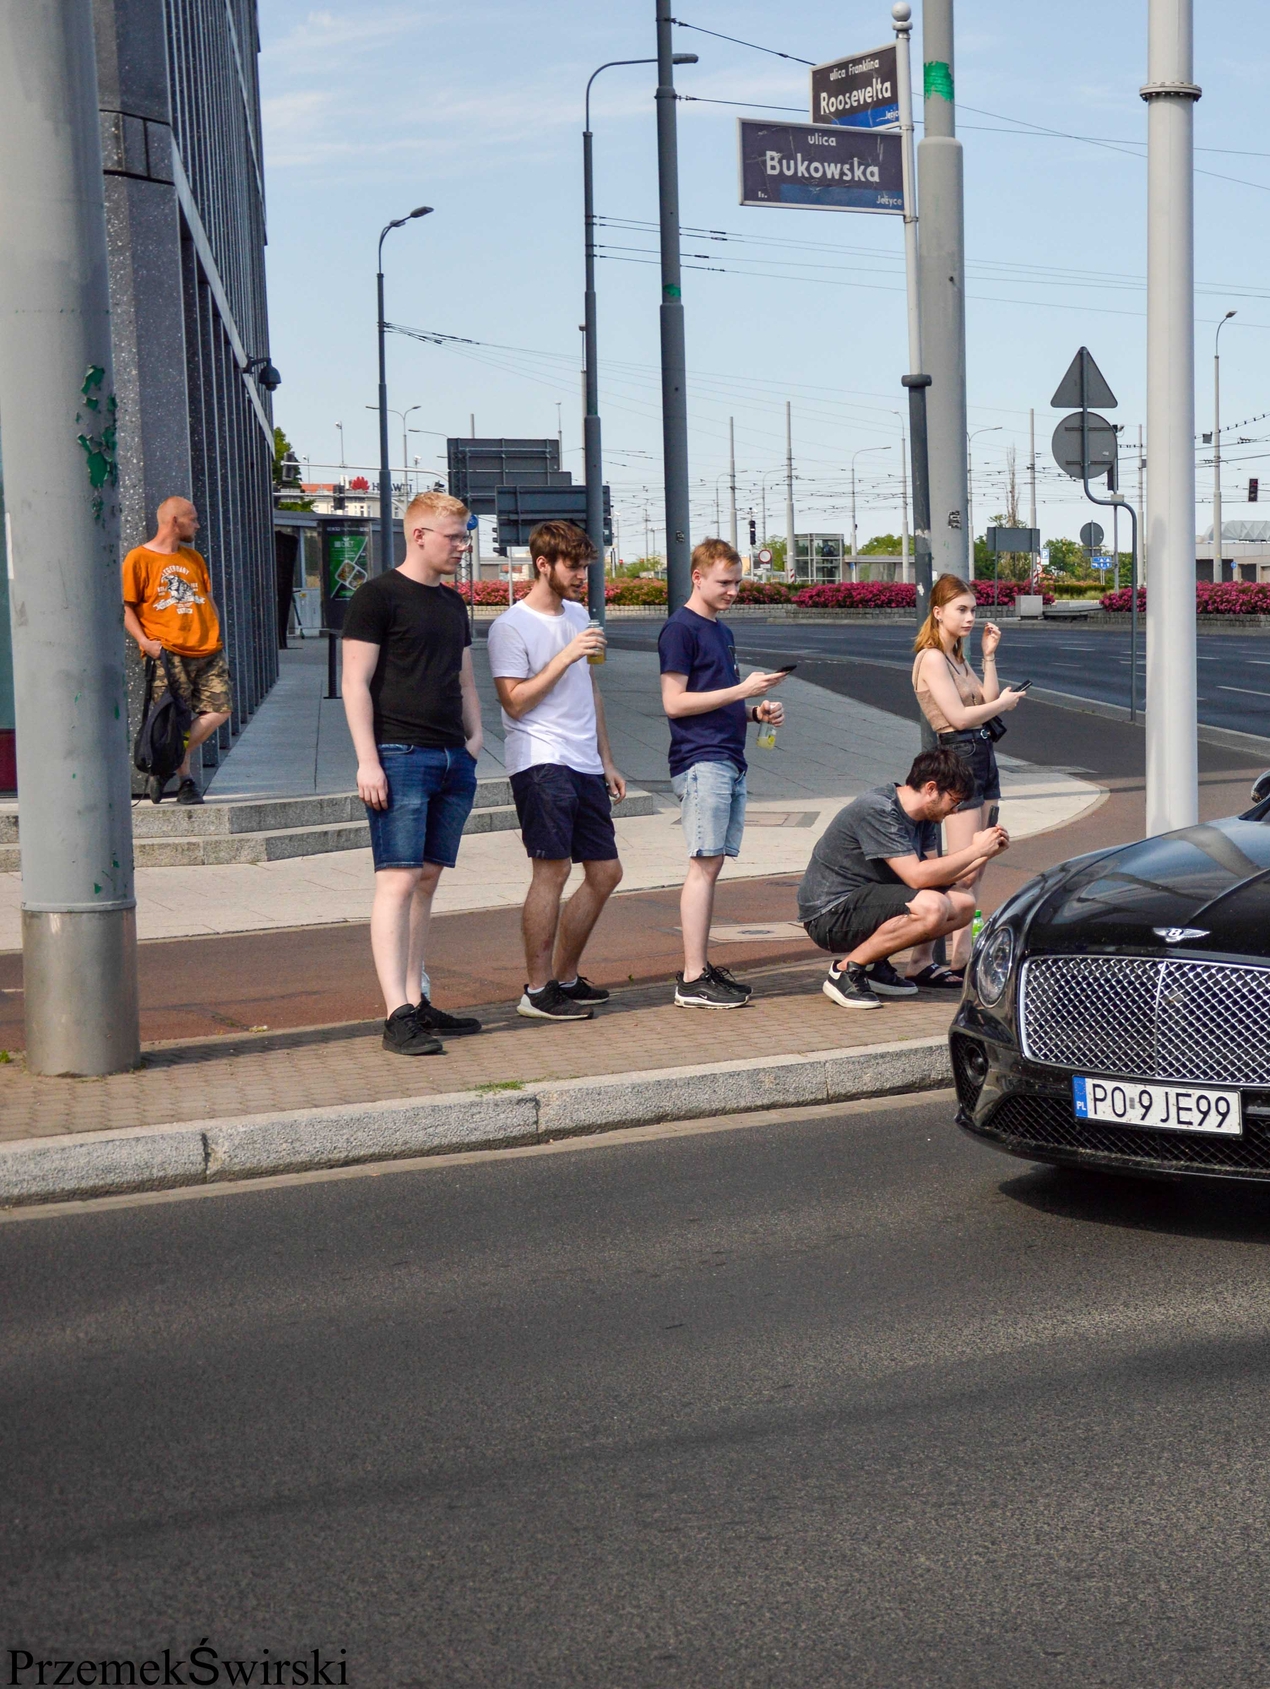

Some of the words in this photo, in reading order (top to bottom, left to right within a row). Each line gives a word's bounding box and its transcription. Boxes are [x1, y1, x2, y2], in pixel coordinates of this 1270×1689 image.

[829, 68, 846, 81] ulica
[848, 58, 880, 76] Franklina
[819, 78, 892, 115] Roosevelta
[807, 132, 837, 147] ulica
[765, 150, 881, 183] Bukowska
[1076, 1101, 1087, 1111] PL
